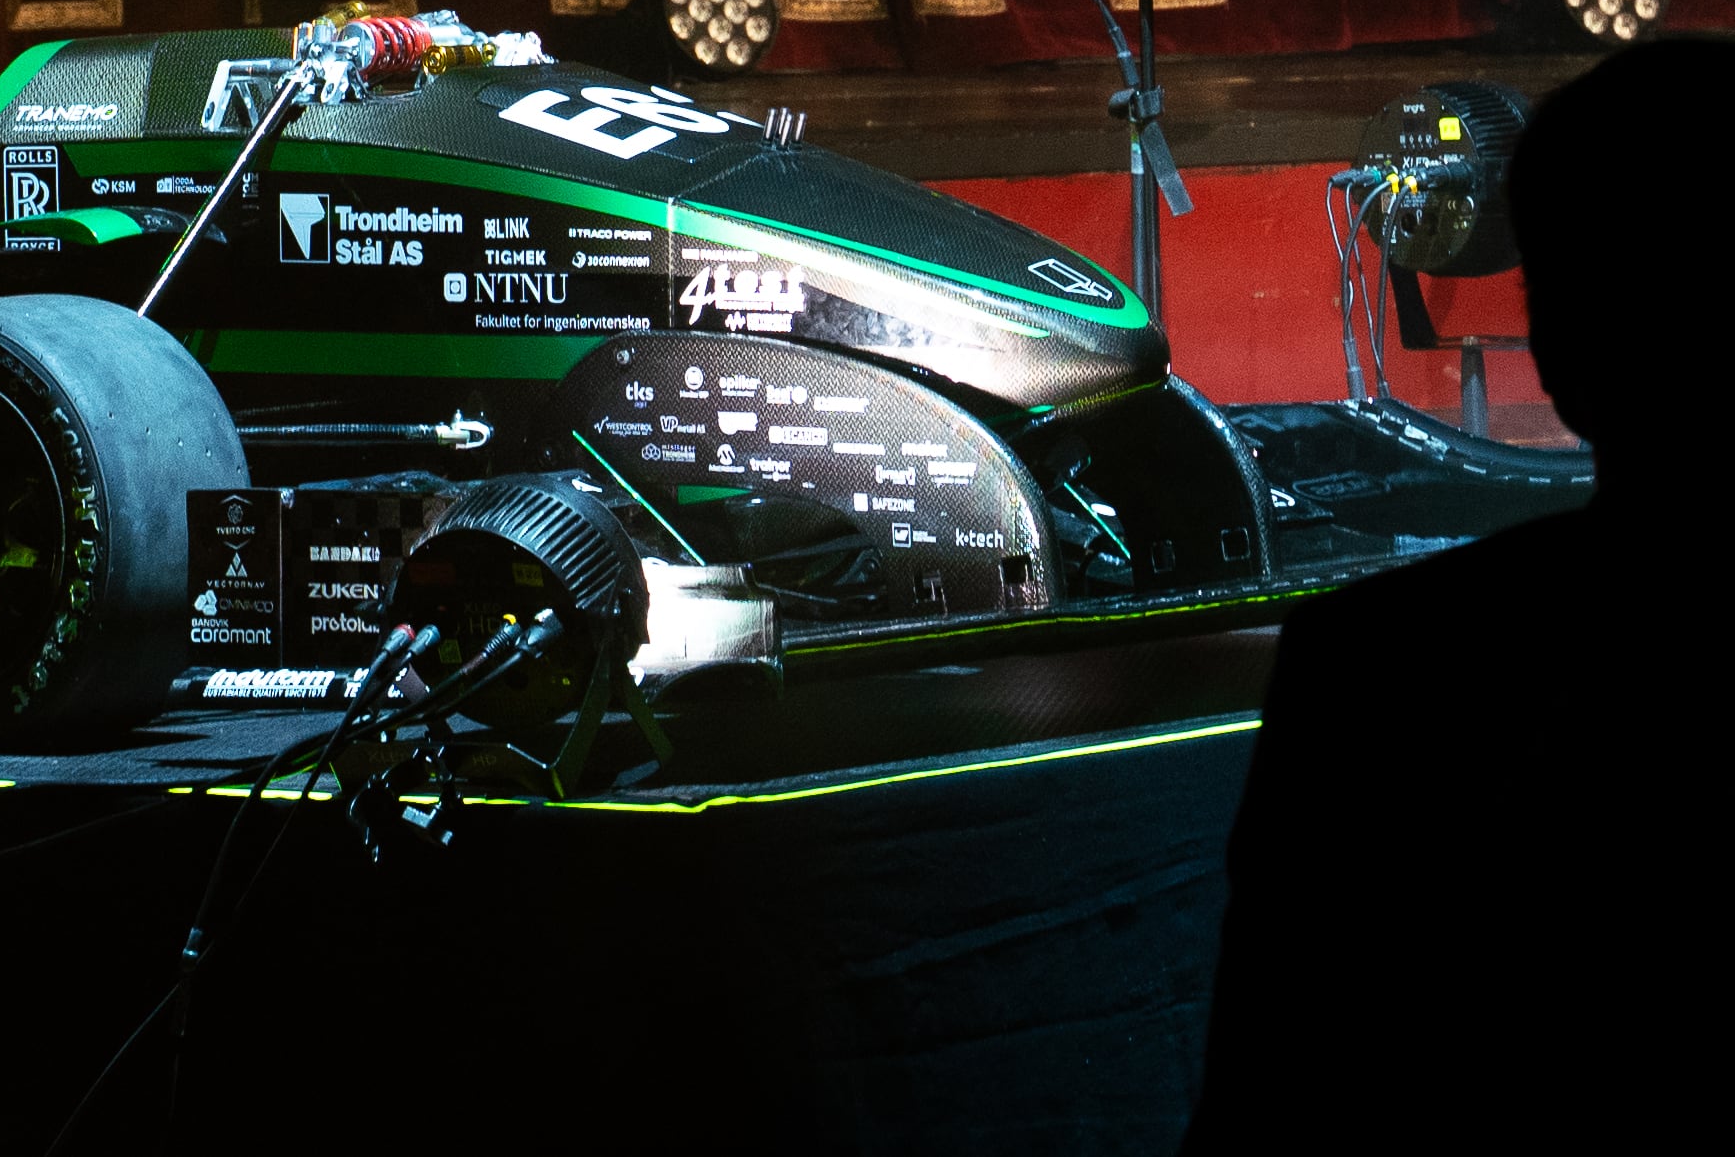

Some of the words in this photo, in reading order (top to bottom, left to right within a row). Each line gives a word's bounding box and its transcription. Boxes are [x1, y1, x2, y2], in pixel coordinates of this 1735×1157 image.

[16, 104, 118, 122] TRANEMO
[498, 85, 765, 160] E6
[9, 151, 52, 163] ROLLS
[111, 180, 136, 193] KSM
[335, 205, 463, 233] Trondheim
[577, 228, 612, 240] TRACO
[614, 230, 652, 241] POWER
[335, 237, 382, 265] Stål
[389, 240, 424, 266] AS
[485, 249, 547, 266] TIGMEK
[473, 272, 568, 304] NTNU
[475, 314, 522, 329] Fakultet
[524, 314, 542, 329] for
[626, 381, 654, 402] tks
[206, 580, 265, 588] VECTORNAV
[308, 583, 379, 600] ZUKEN
[191, 628, 271, 644] coromant
